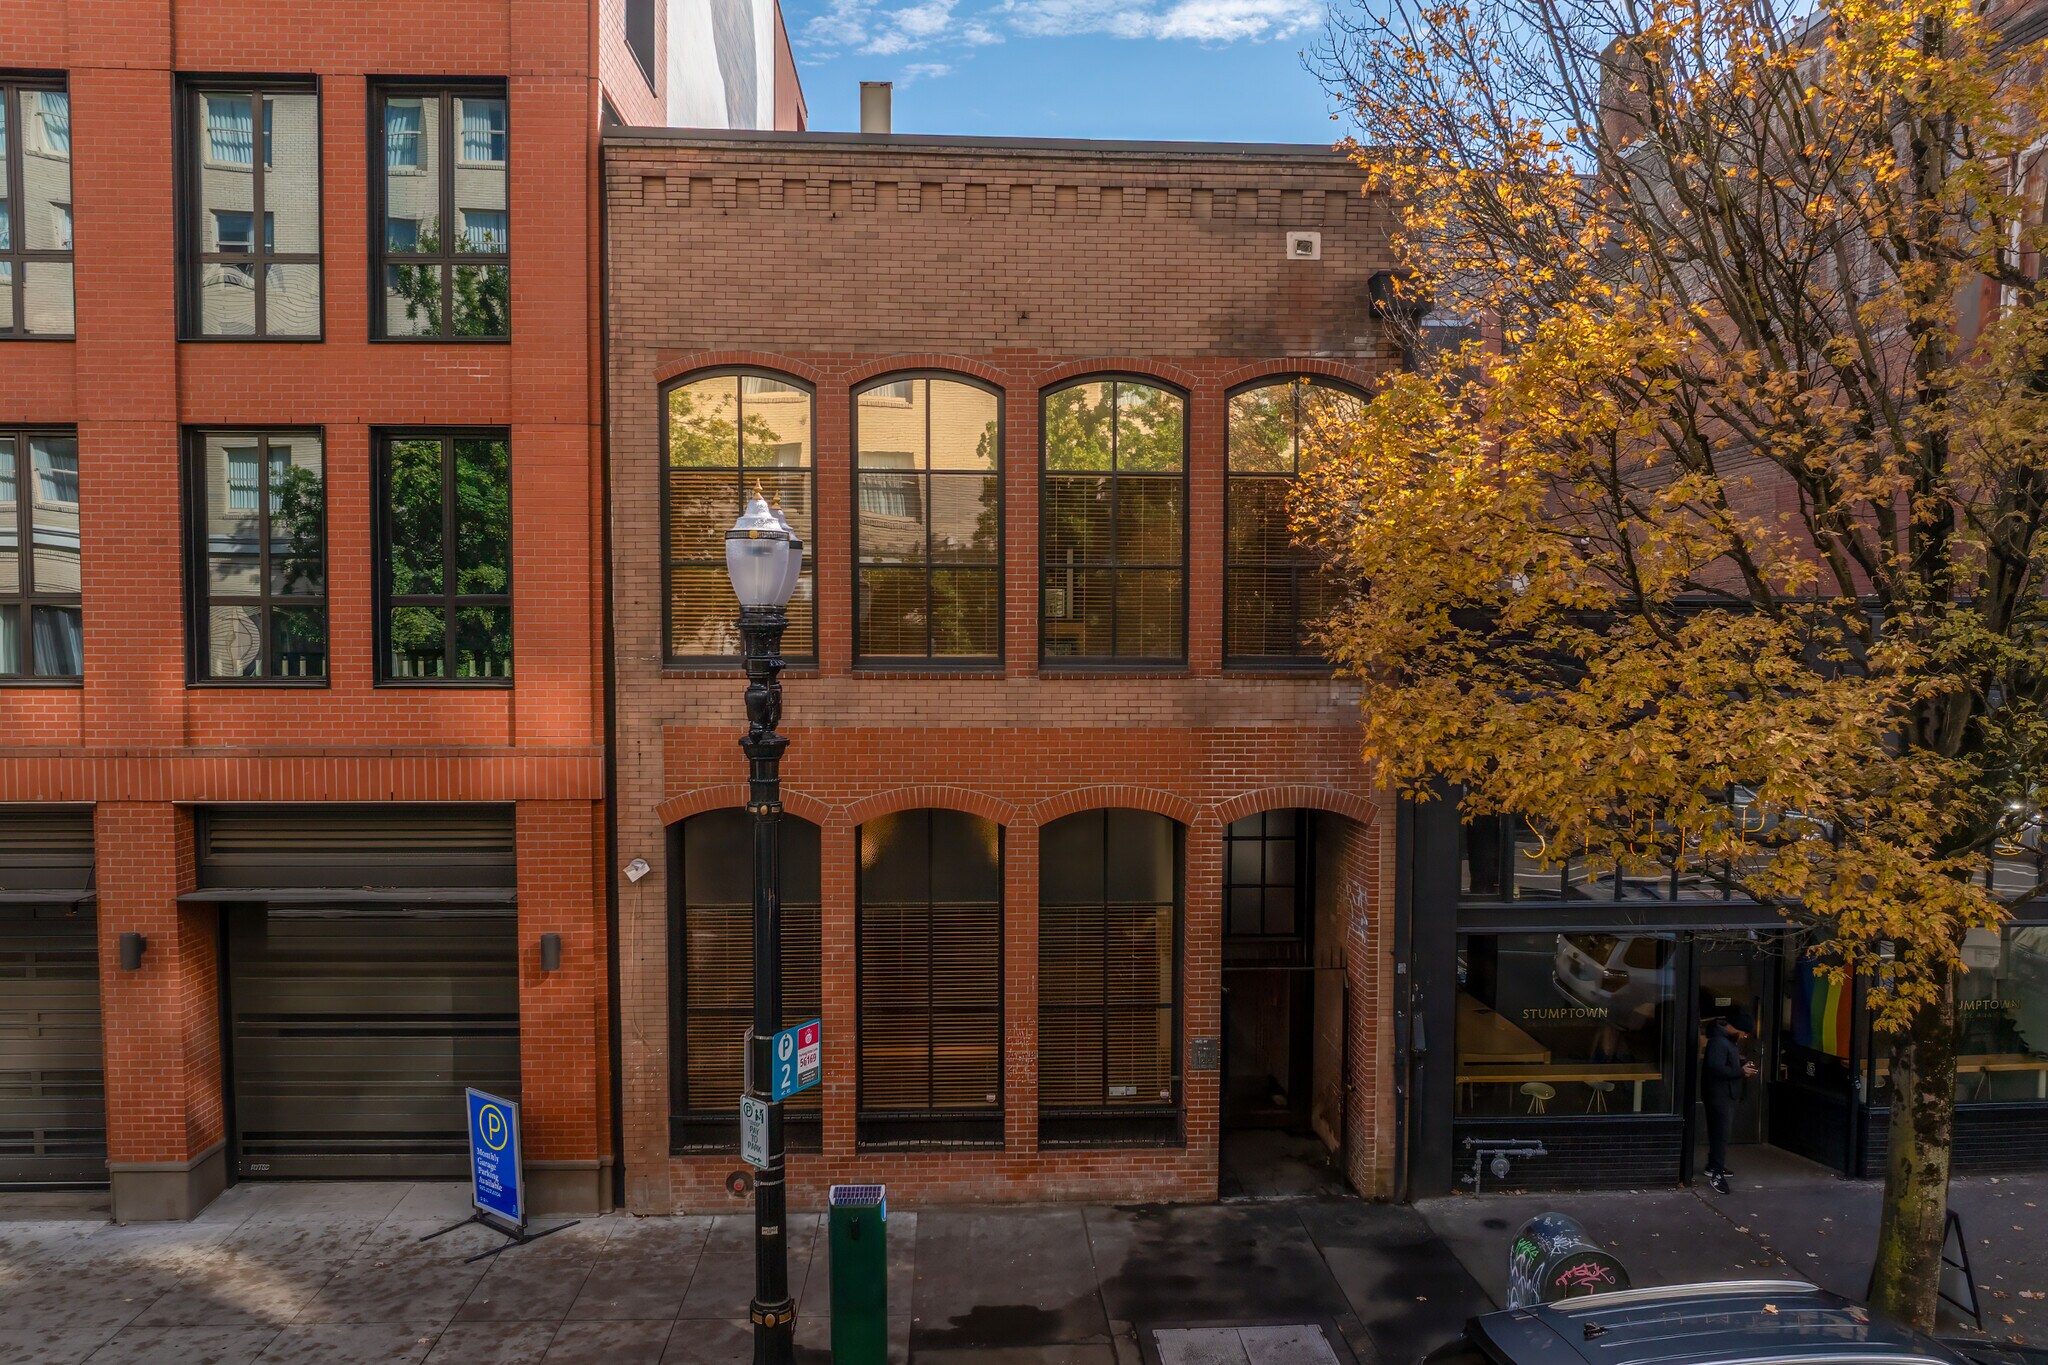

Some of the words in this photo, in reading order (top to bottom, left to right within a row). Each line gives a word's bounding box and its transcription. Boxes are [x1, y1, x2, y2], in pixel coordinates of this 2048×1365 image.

[1958, 1000, 2020, 1010] UMPTOWN
[1523, 1008, 1608, 1019] STUMPTOWN
[783, 1038, 790, 1057] P
[781, 1063, 791, 1089] 2
[488, 1113, 501, 1140] P
[749, 1125, 760, 1135] PAY
[751, 1134, 758, 1144] TO
[747, 1141, 762, 1154] PARK
[477, 1147, 499, 1164] Monthly
[477, 1157, 497, 1172] Garage
[478, 1166, 499, 1182] Parking
[478, 1176, 503, 1192] Available
